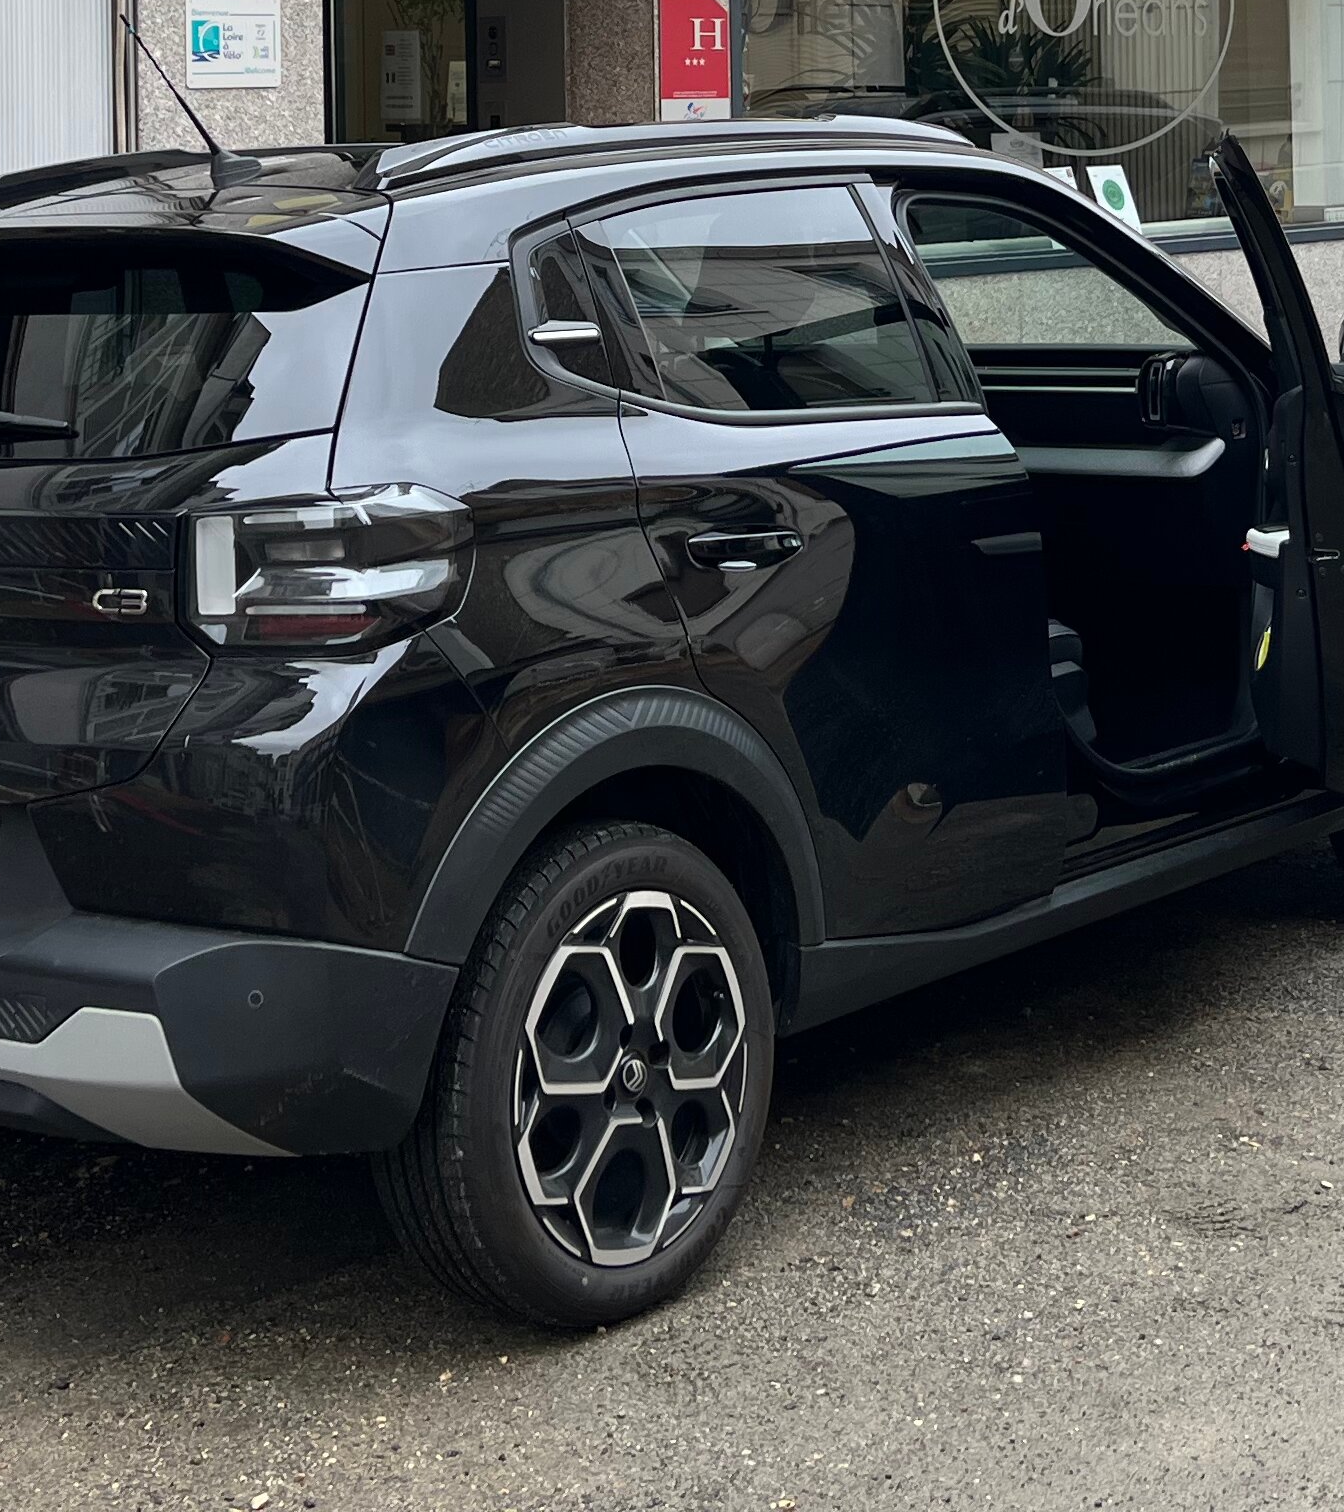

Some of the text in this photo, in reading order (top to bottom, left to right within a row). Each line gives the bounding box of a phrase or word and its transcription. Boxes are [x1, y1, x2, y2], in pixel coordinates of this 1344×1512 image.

[222, 32, 244, 41] Loire
[689, 17, 726, 51] H
[92, 588, 148, 615] C3
